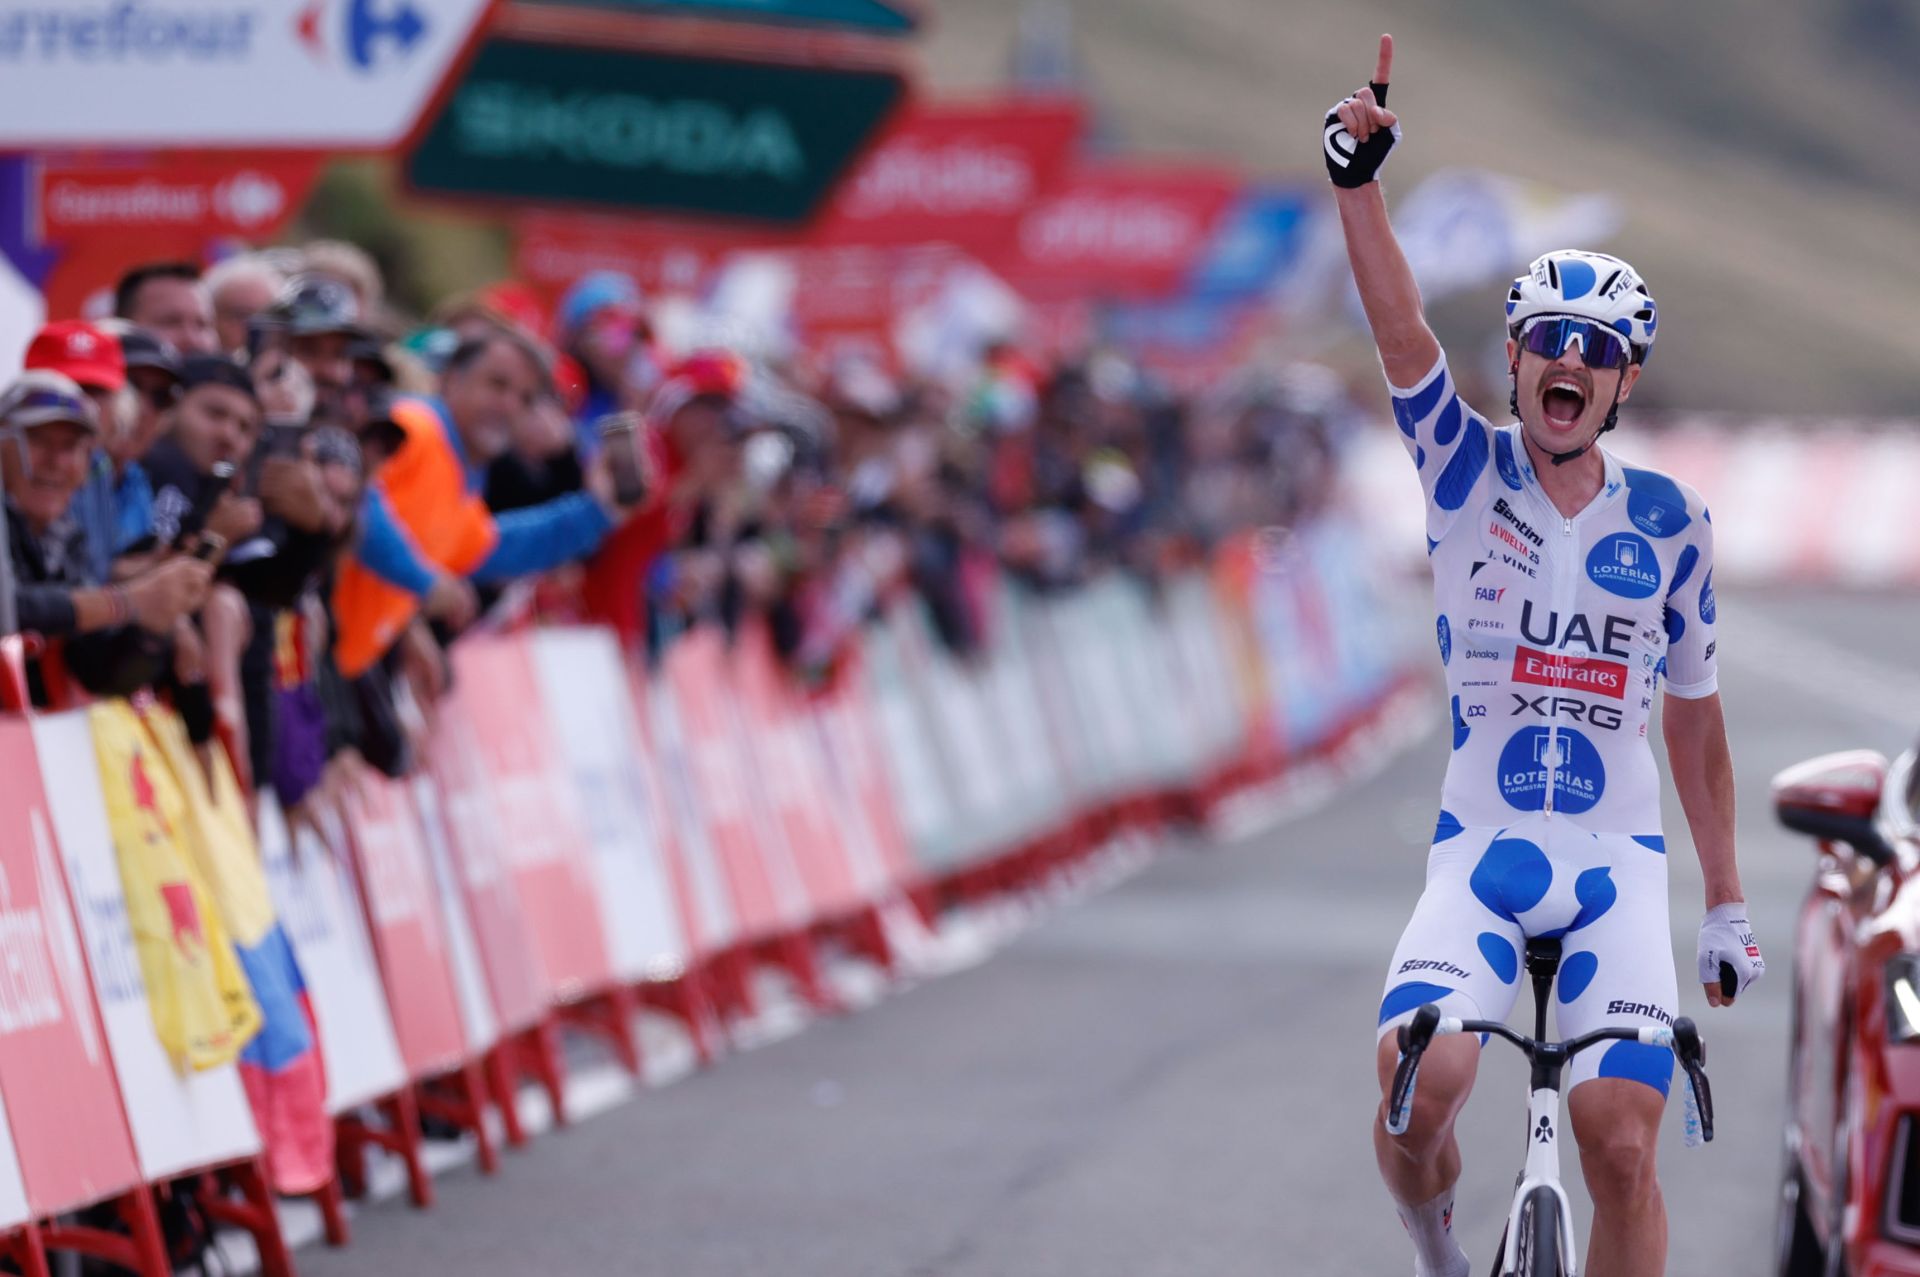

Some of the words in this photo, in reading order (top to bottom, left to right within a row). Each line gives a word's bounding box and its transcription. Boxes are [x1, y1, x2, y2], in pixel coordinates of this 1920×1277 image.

[1608, 269, 1634, 301] MET
[1493, 497, 1544, 547] Santini
[1499, 527, 1528, 557] VUELTA
[1529, 550, 1540, 565] 25
[1488, 549, 1497, 560] J.
[1503, 553, 1537, 580] VINE
[1520, 598, 1637, 660] UAE
[1472, 649, 1499, 661] Analog
[1525, 656, 1618, 688] Emirates
[1510, 692, 1623, 731] XRG
[1510, 783, 1546, 794] APUESTAS
[1566, 787, 1596, 801] ESTADO
[1397, 959, 1471, 979] Santini
[1606, 1000, 1674, 1028] Santini
